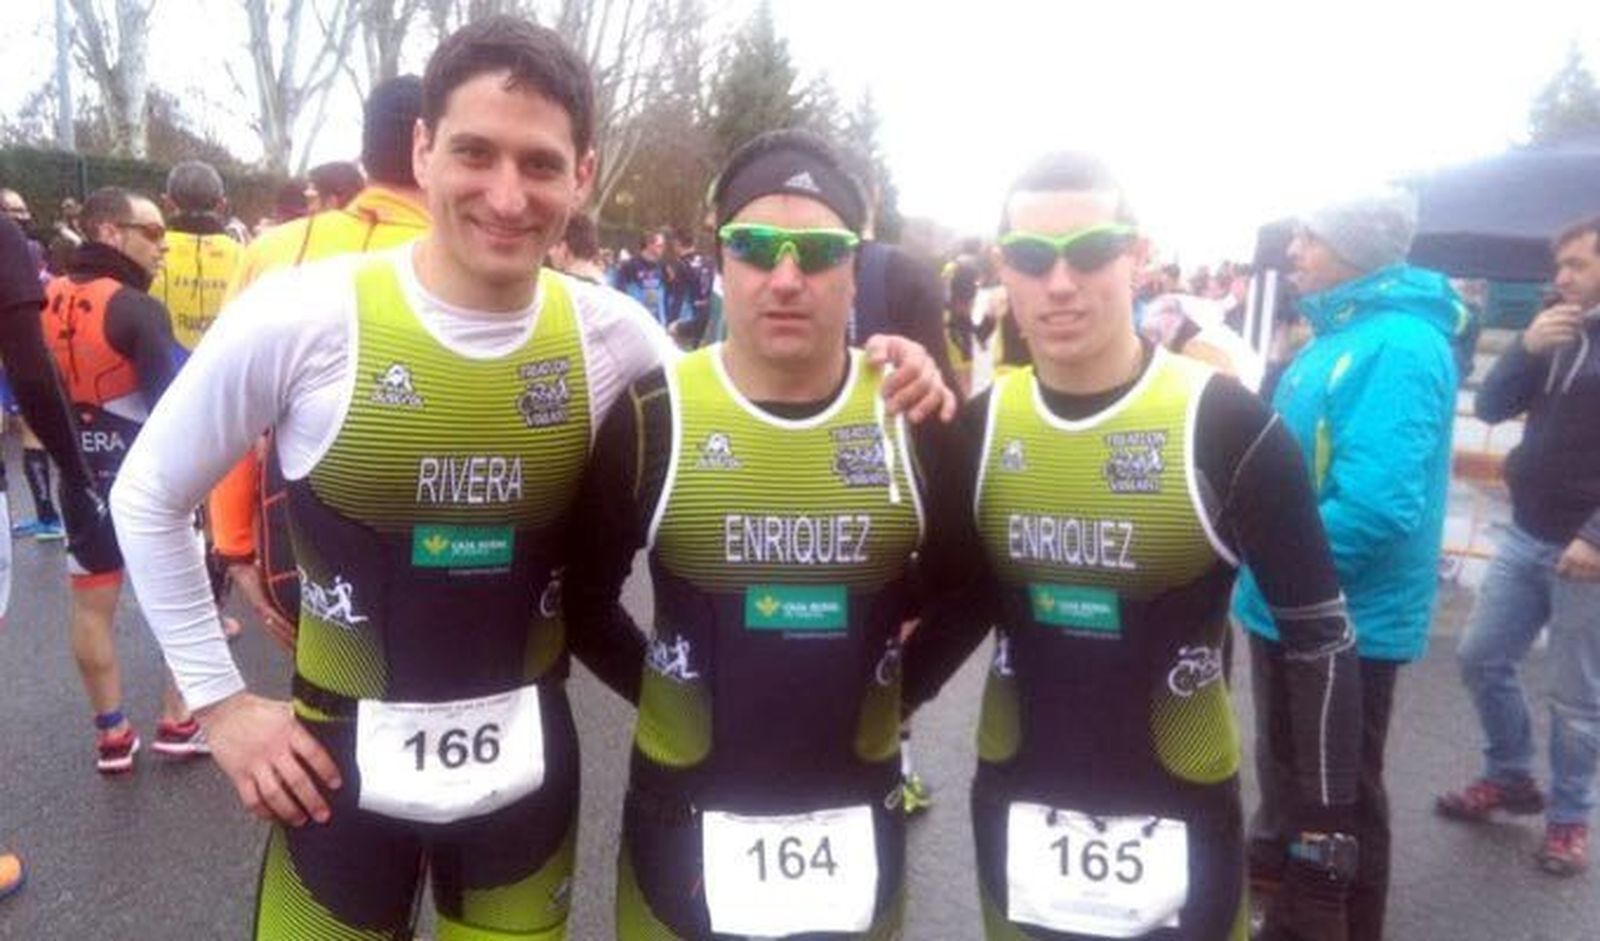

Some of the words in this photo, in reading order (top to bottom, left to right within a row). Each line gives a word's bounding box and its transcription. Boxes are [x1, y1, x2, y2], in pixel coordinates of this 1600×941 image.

[81, 431, 126, 452] ERA
[415, 456, 523, 504] RIVERA
[724, 514, 871, 564] ENRIQUEZ
[1008, 514, 1136, 570] ENRIQUEZ
[403, 723, 500, 771] 166
[746, 836, 839, 882] 164
[1050, 835, 1143, 884] 165
